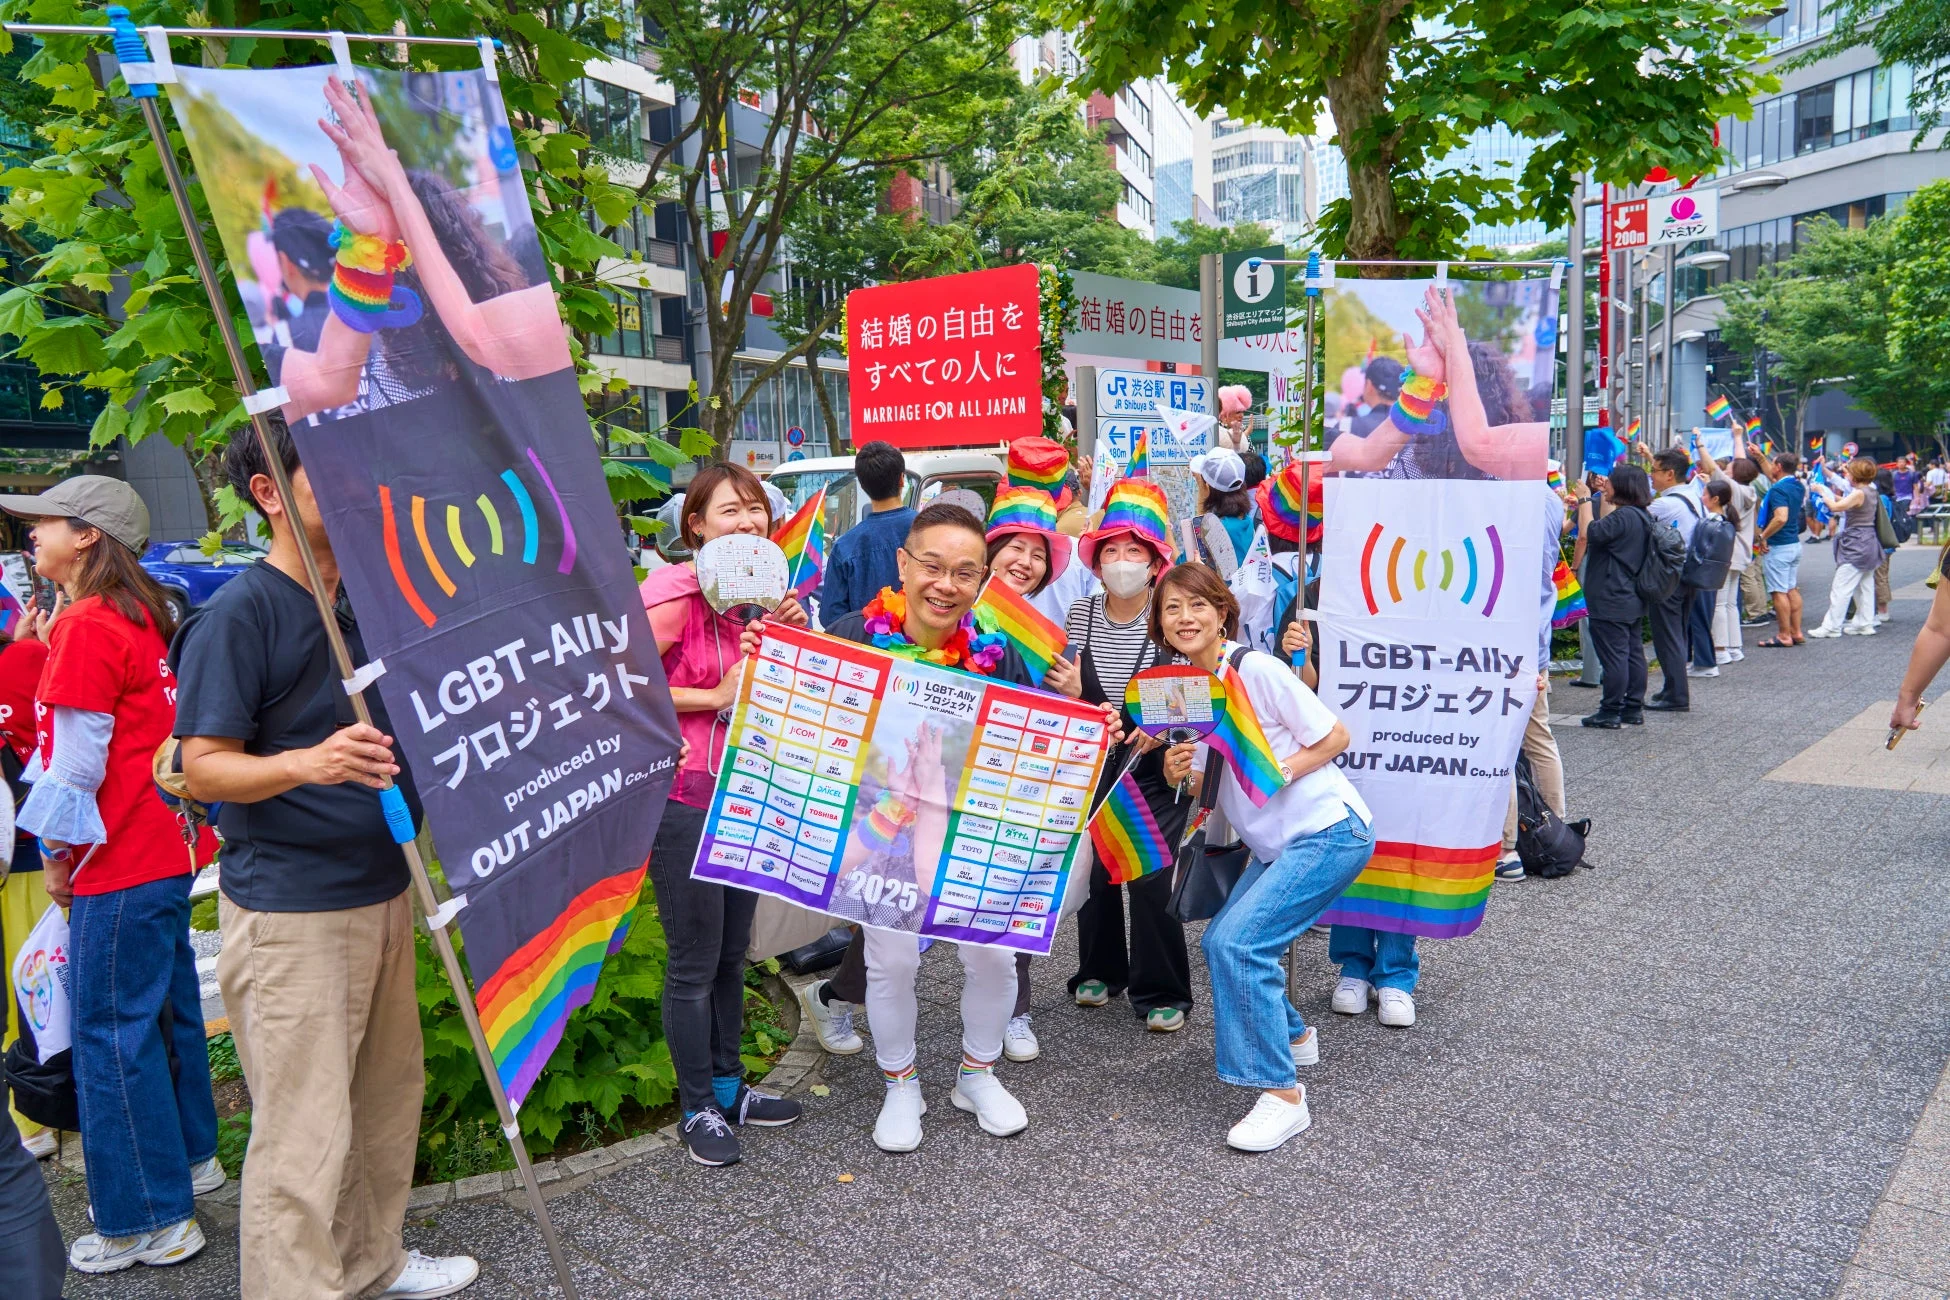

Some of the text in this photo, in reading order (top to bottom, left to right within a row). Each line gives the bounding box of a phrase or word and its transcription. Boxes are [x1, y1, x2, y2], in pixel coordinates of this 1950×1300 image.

[1614, 230, 1645, 247] 200m
[1660, 224, 1708, 240] バーミヤン
[1081, 296, 1202, 342] 結婚の自由を
[1226, 306, 1284, 321] 渋谷区エリアマップ
[860, 302, 1024, 350] 結婚の自由を
[865, 350, 1016, 392] すべての人に
[1108, 376, 1166, 398] JR 渋谷駅
[863, 397, 1026, 424] MARRIAGE FOR ALL JAPAN
[1114, 400, 1122, 410] JR
[1124, 400, 1146, 412] Shibuya
[1190, 403, 1206, 412] 700m
[1258, 561, 1267, 584] ALLY
[808, 656, 828, 665] Asahi
[1339, 640, 1523, 680] LGBT-Ally
[410, 613, 630, 734] LGBT-Ally
[804, 682, 825, 692] ENEOS
[926, 682, 976, 702] LGBT-Ally
[924, 693, 974, 712] プロジェクト
[1338, 681, 1524, 716] プロジェクト
[1001, 710, 1025, 721] idemitsu
[1036, 718, 1052, 726] ANA
[432, 663, 649, 790] プロジェクト
[789, 726, 815, 739] J:COM
[1079, 725, 1096, 734] AGC
[832, 737, 848, 747] JTB
[1372, 730, 1480, 748] produced by
[737, 756, 769, 772] SONY
[1332, 751, 1382, 770] OUT
[1385, 754, 1468, 776] JAPAN
[504, 734, 621, 812] produced by
[817, 786, 841, 797] DAICEL
[780, 798, 795, 808] TDK
[729, 805, 752, 817] NSK
[810, 808, 838, 820] TOSHIBA
[471, 820, 532, 878] OUT
[538, 768, 622, 840] JAPAN
[725, 831, 753, 841] FamilyMart
[1005, 828, 1029, 840] ダイナム
[961, 844, 982, 854] TOTO
[792, 872, 820, 887] Ridgelinez
[993, 875, 1018, 884] Medtronic
[846, 870, 918, 912] 2025
[1020, 901, 1044, 911] meiji
[976, 917, 1006, 927] LAWSON
